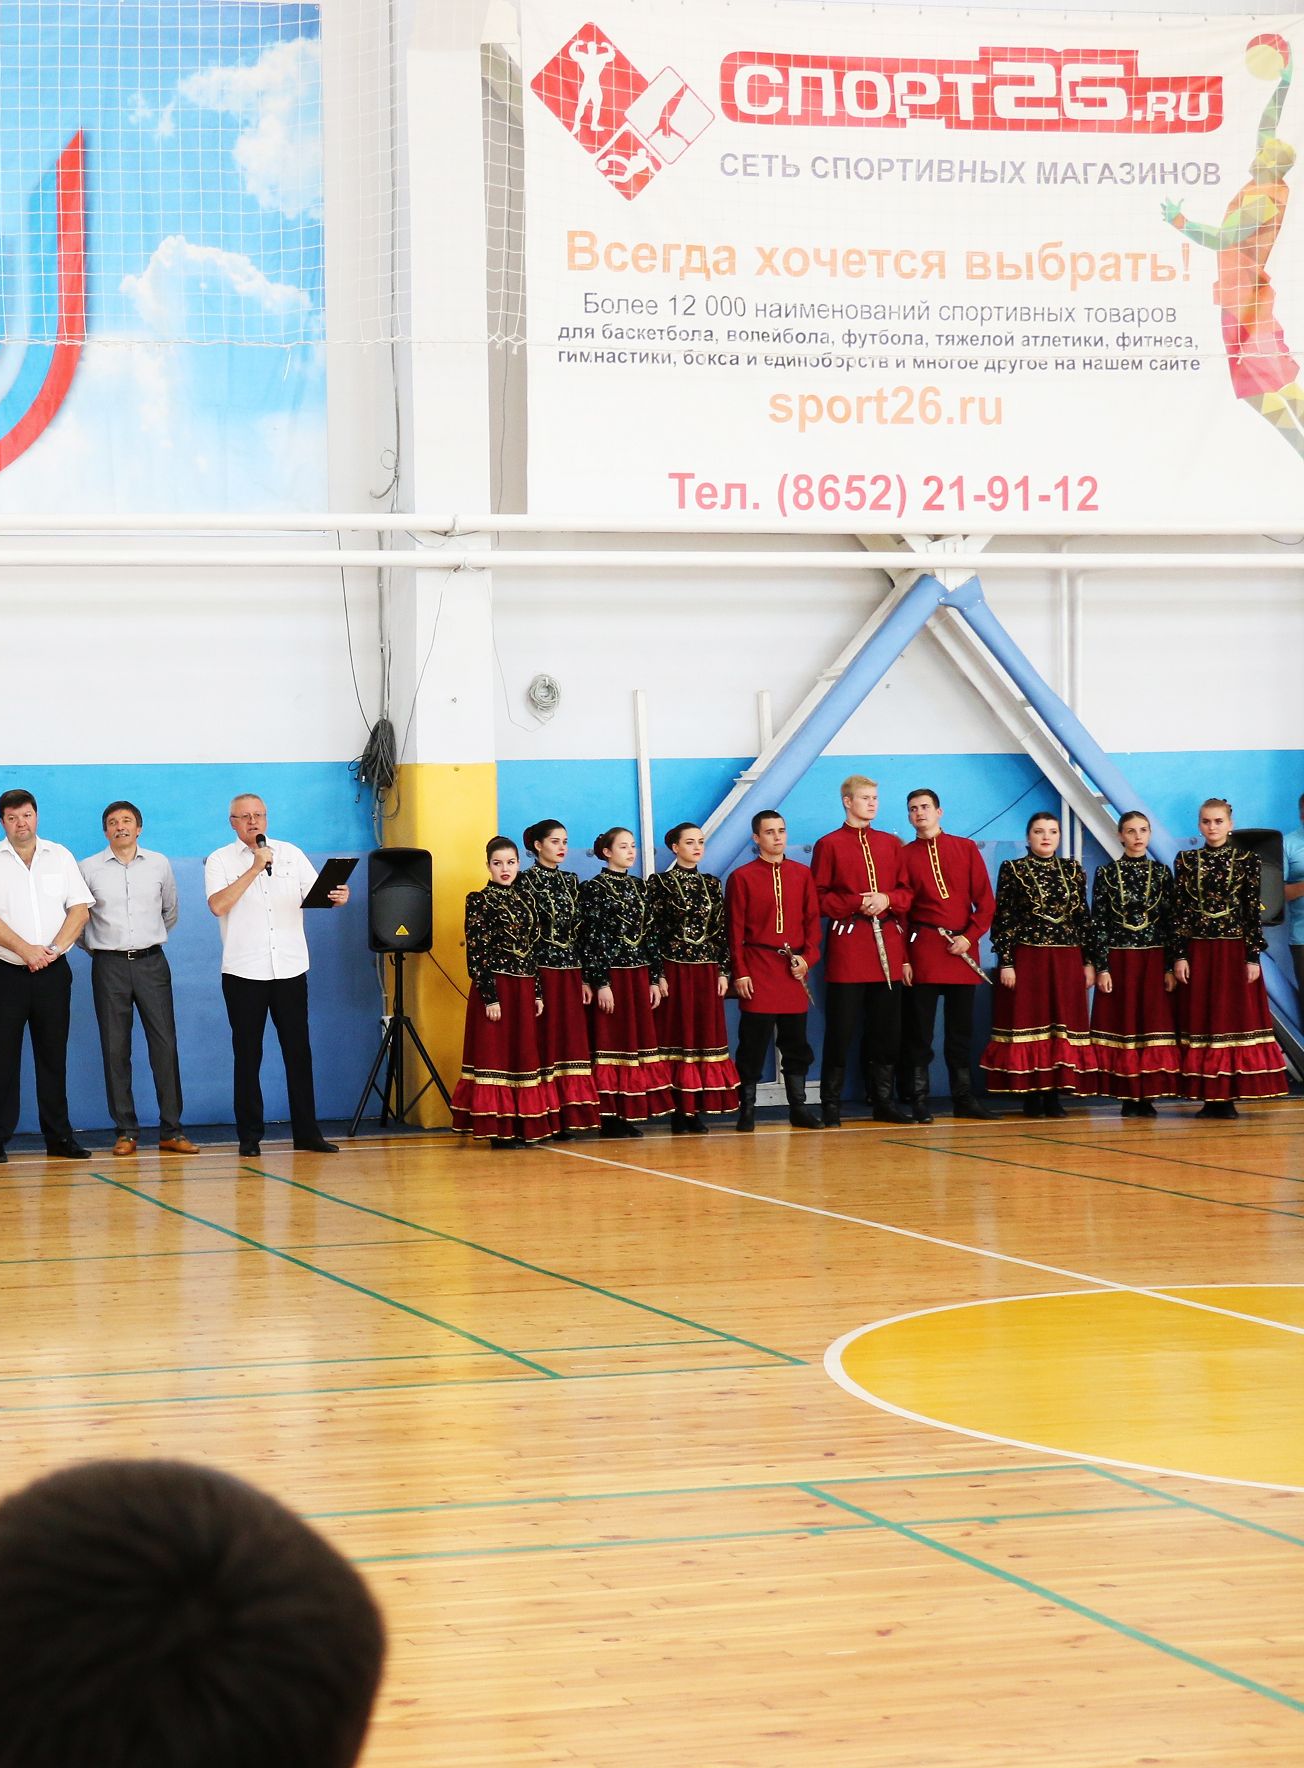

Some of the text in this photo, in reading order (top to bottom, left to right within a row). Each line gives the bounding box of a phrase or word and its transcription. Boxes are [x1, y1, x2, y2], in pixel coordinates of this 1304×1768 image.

[720, 153, 1222, 186] СЕТЬ СПОРТИВНЫХ МАГАЗИНОВ
[567, 230, 1191, 291] Всегда хочется выбрать!
[583, 292, 1177, 328] Более 12 000 наименований спортивных товаров
[558, 324, 1199, 350] для баскетбола, волейбола, футбола, тяжелой атлетики, фитнеса,
[558, 349, 677, 366] гимнастики,
[683, 349, 739, 366] бокса
[747, 355, 757, 365] и
[764, 352, 889, 371] единоборств
[895, 358, 906, 369] и
[912, 358, 979, 370] многое
[984, 359, 1048, 374] другое
[1054, 359, 1076, 371] на
[1082, 359, 1143, 371] нашем
[768, 386, 1003, 433] sport26.ru
[668, 472, 1098, 518] Тел. (8652) 21-91-12
